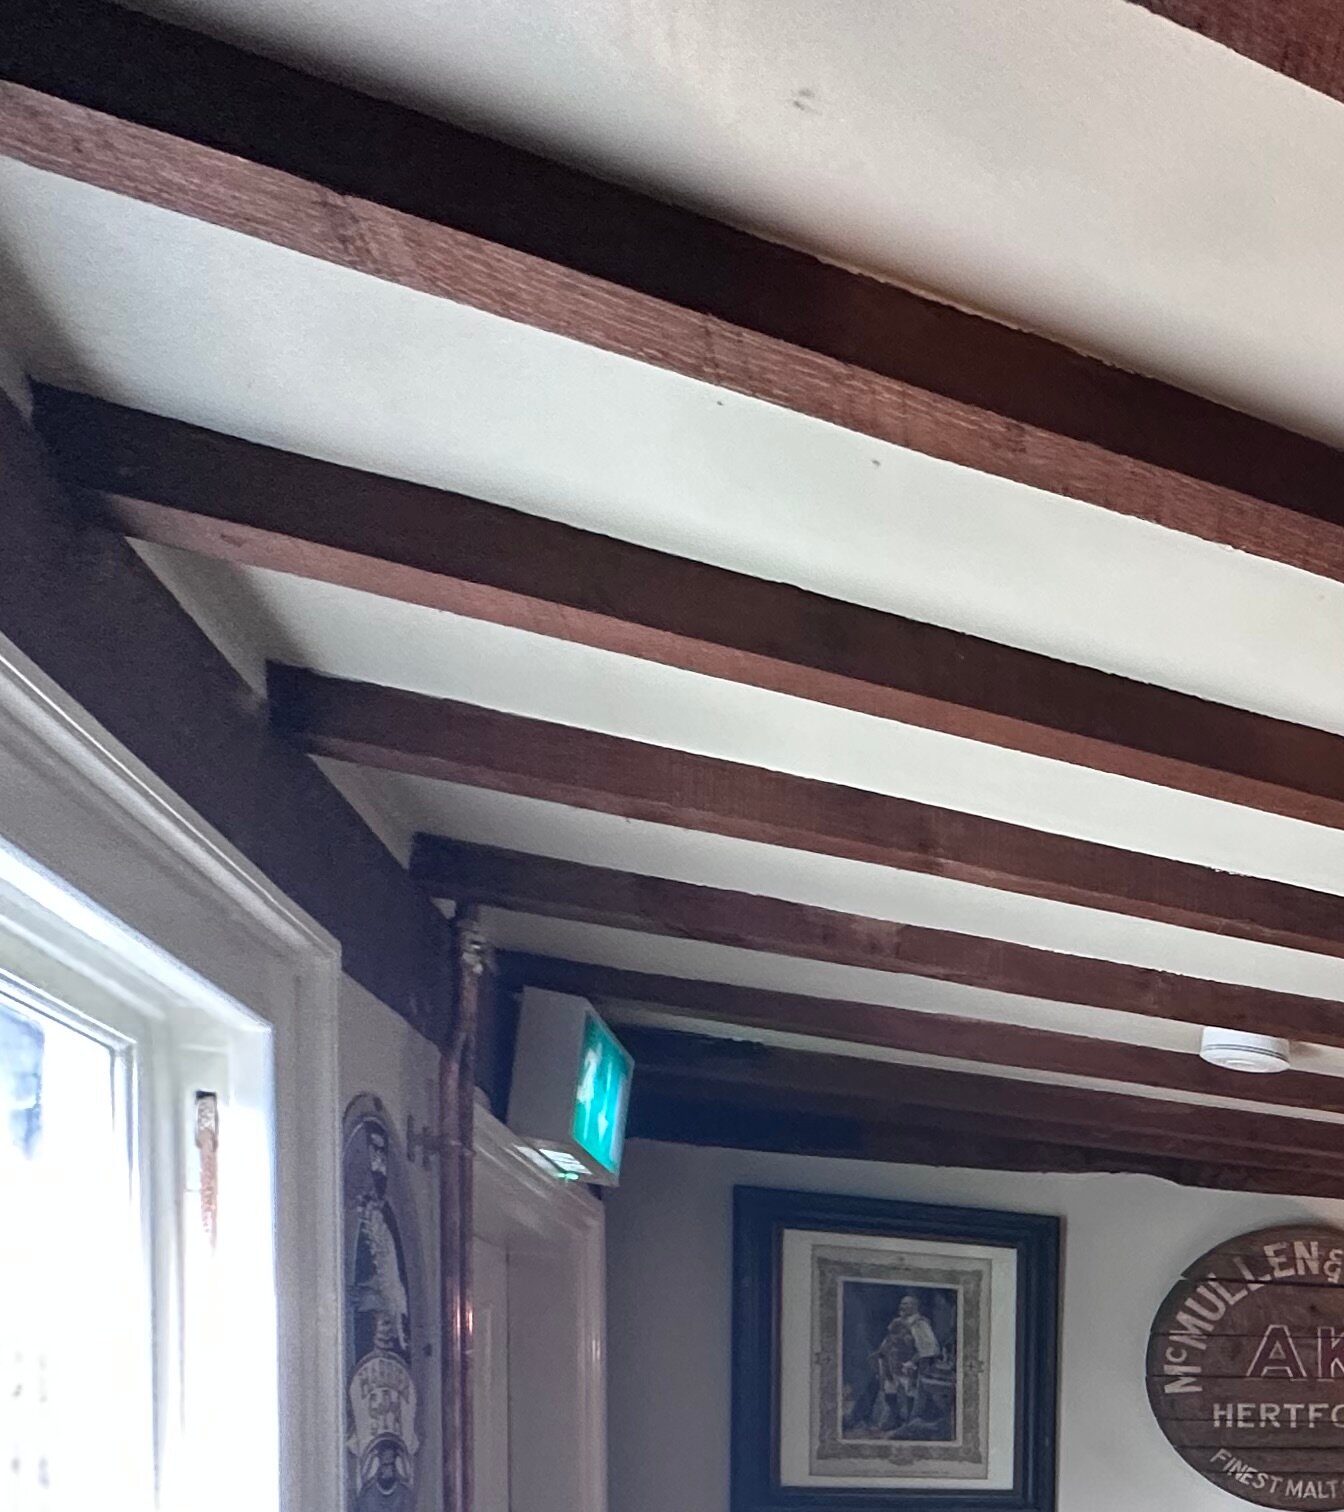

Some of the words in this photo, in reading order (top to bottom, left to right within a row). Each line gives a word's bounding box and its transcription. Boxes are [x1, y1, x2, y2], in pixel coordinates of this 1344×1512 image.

[1323, 1249, 1344, 1284] &
[1208, 1448, 1284, 1495] FINEST
[1284, 1479, 1339, 1501] MALT
